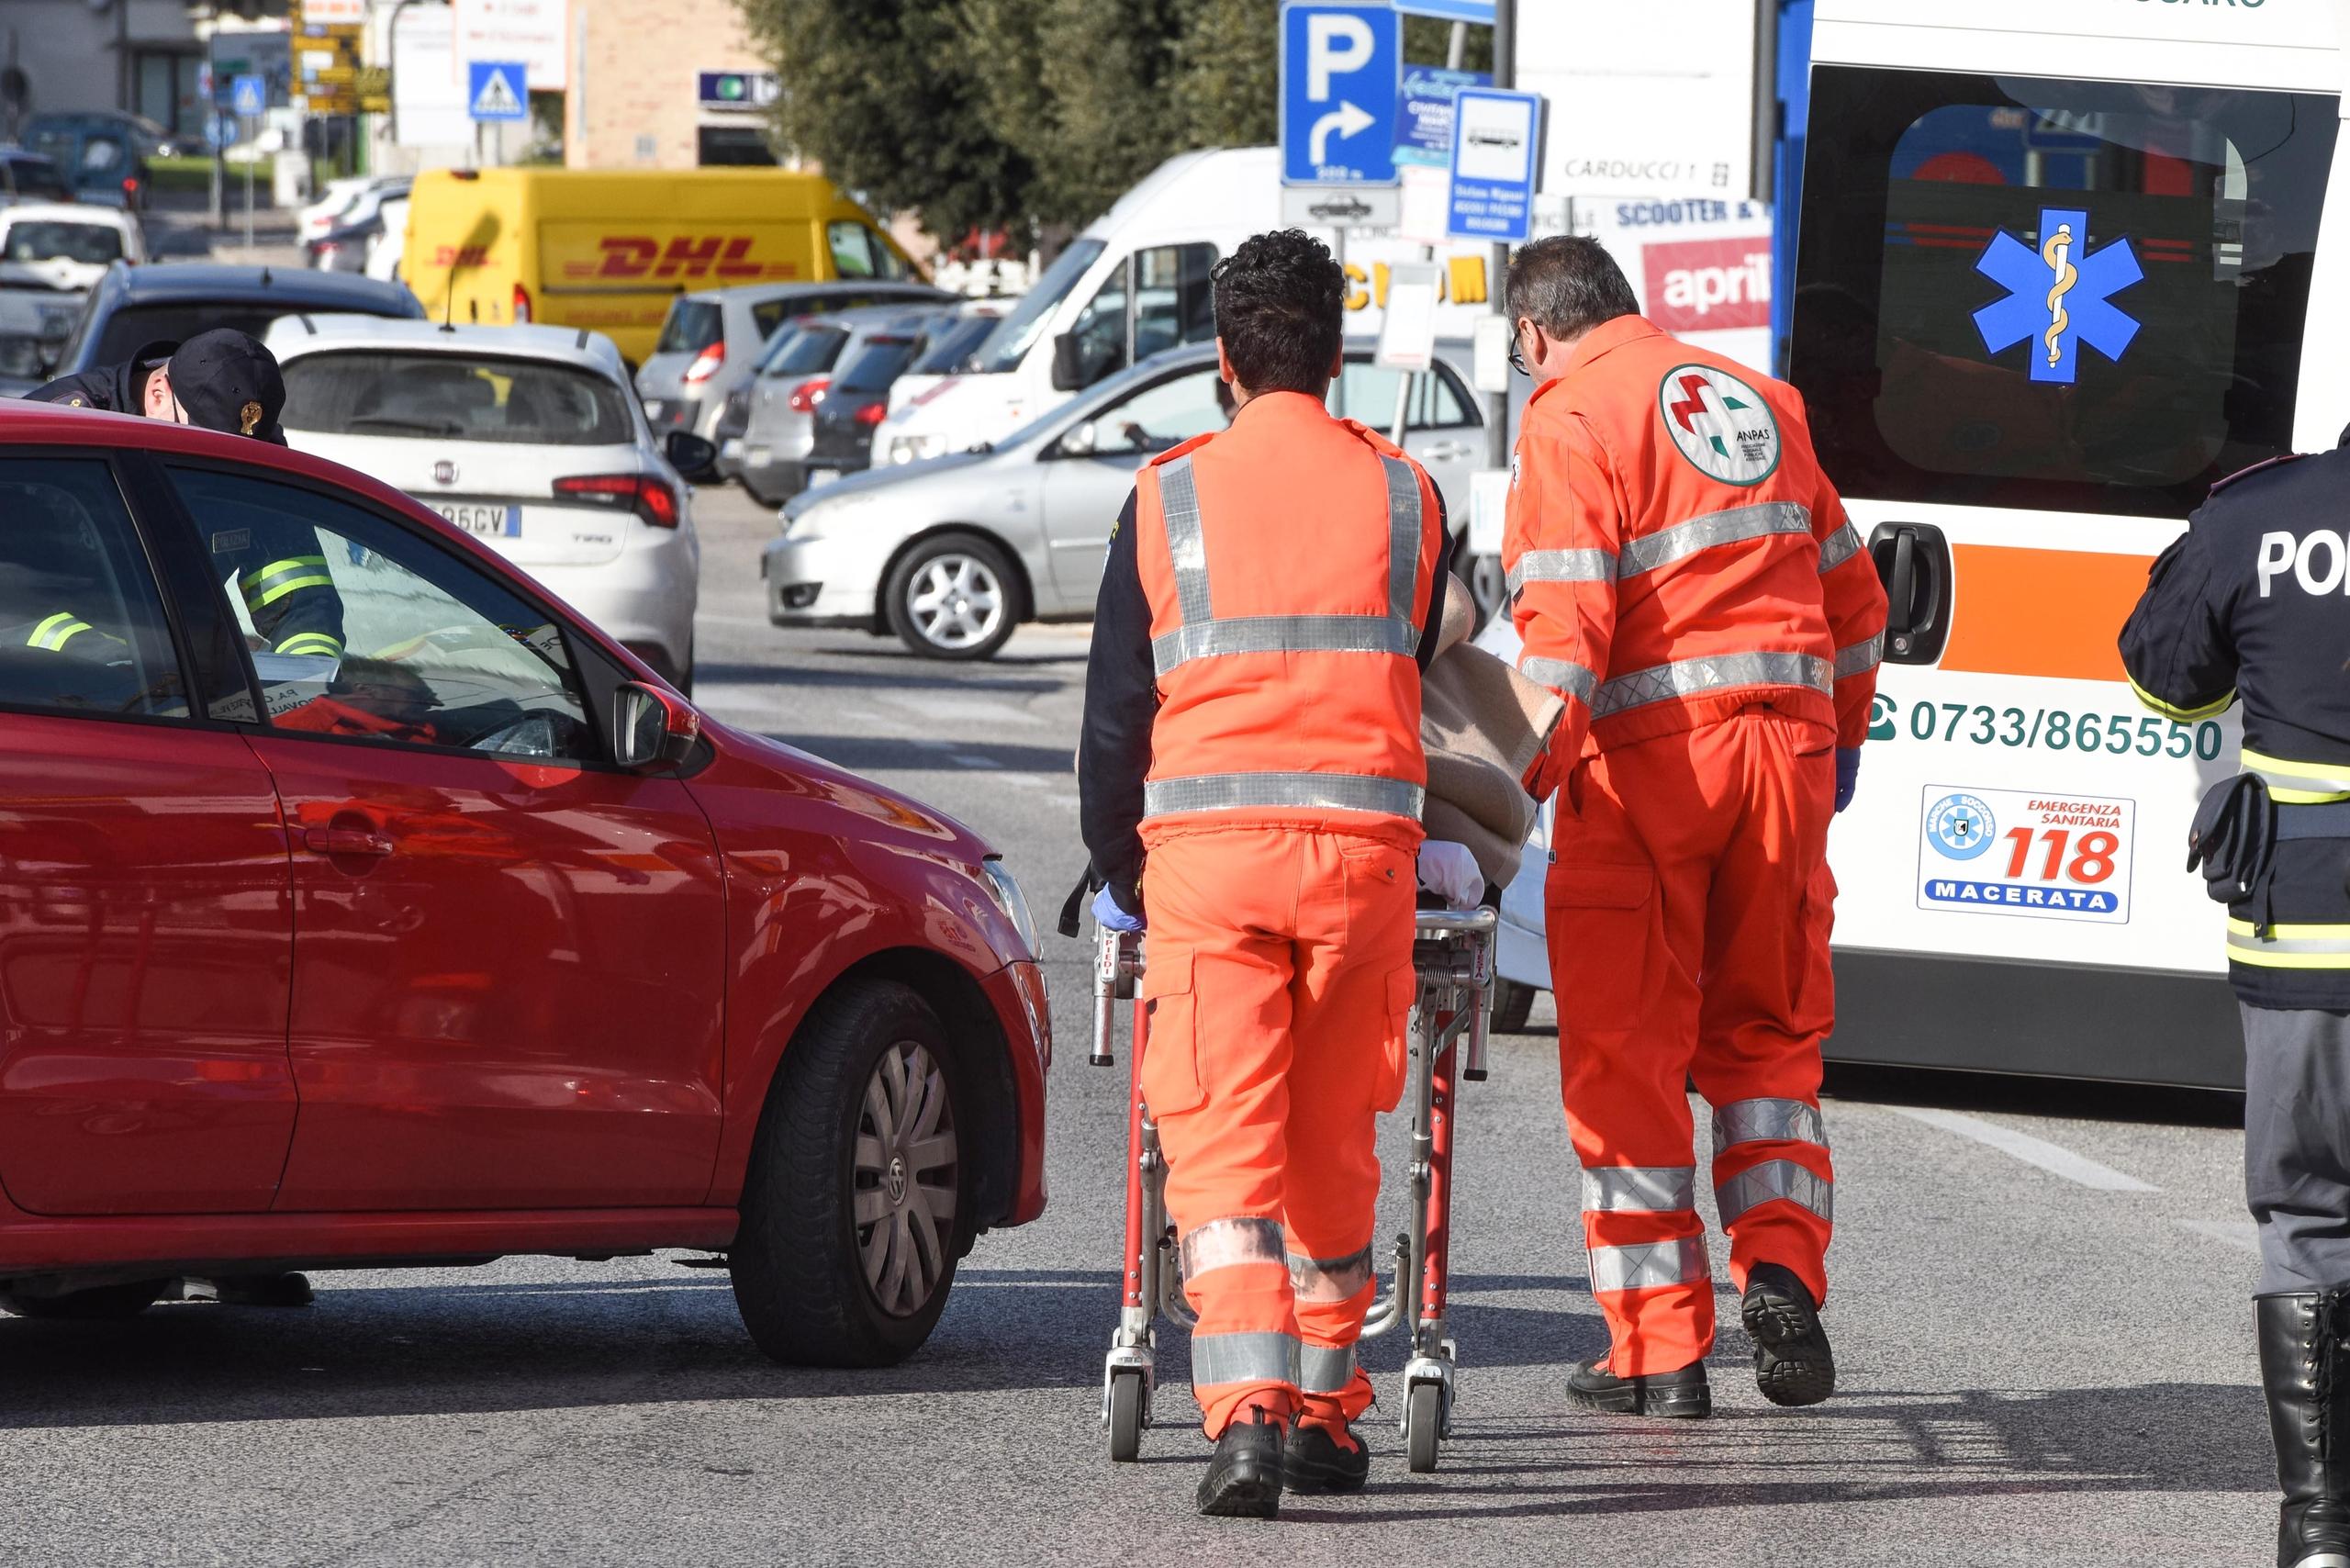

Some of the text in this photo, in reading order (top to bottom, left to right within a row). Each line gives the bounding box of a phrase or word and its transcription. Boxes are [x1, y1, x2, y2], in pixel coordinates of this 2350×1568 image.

[1306, 14, 1375, 102] P
[1565, 160, 1680, 181] CARDUCCI
[1616, 199, 1727, 228] SCOOTER
[599, 236, 764, 276] DHL
[1737, 429, 1770, 442] ANPAS
[2256, 529, 2350, 599] PO
[1910, 700, 2222, 761] 0733/865550
[1961, 795, 1993, 837] SOCCORSO
[2027, 800, 2121, 816] EMERGENZA
[2041, 812, 2121, 829] SANITARIA
[2004, 827, 2120, 884] 118
[1934, 881, 2108, 911] MACERATA
[1103, 939, 1113, 975] PIEDI
